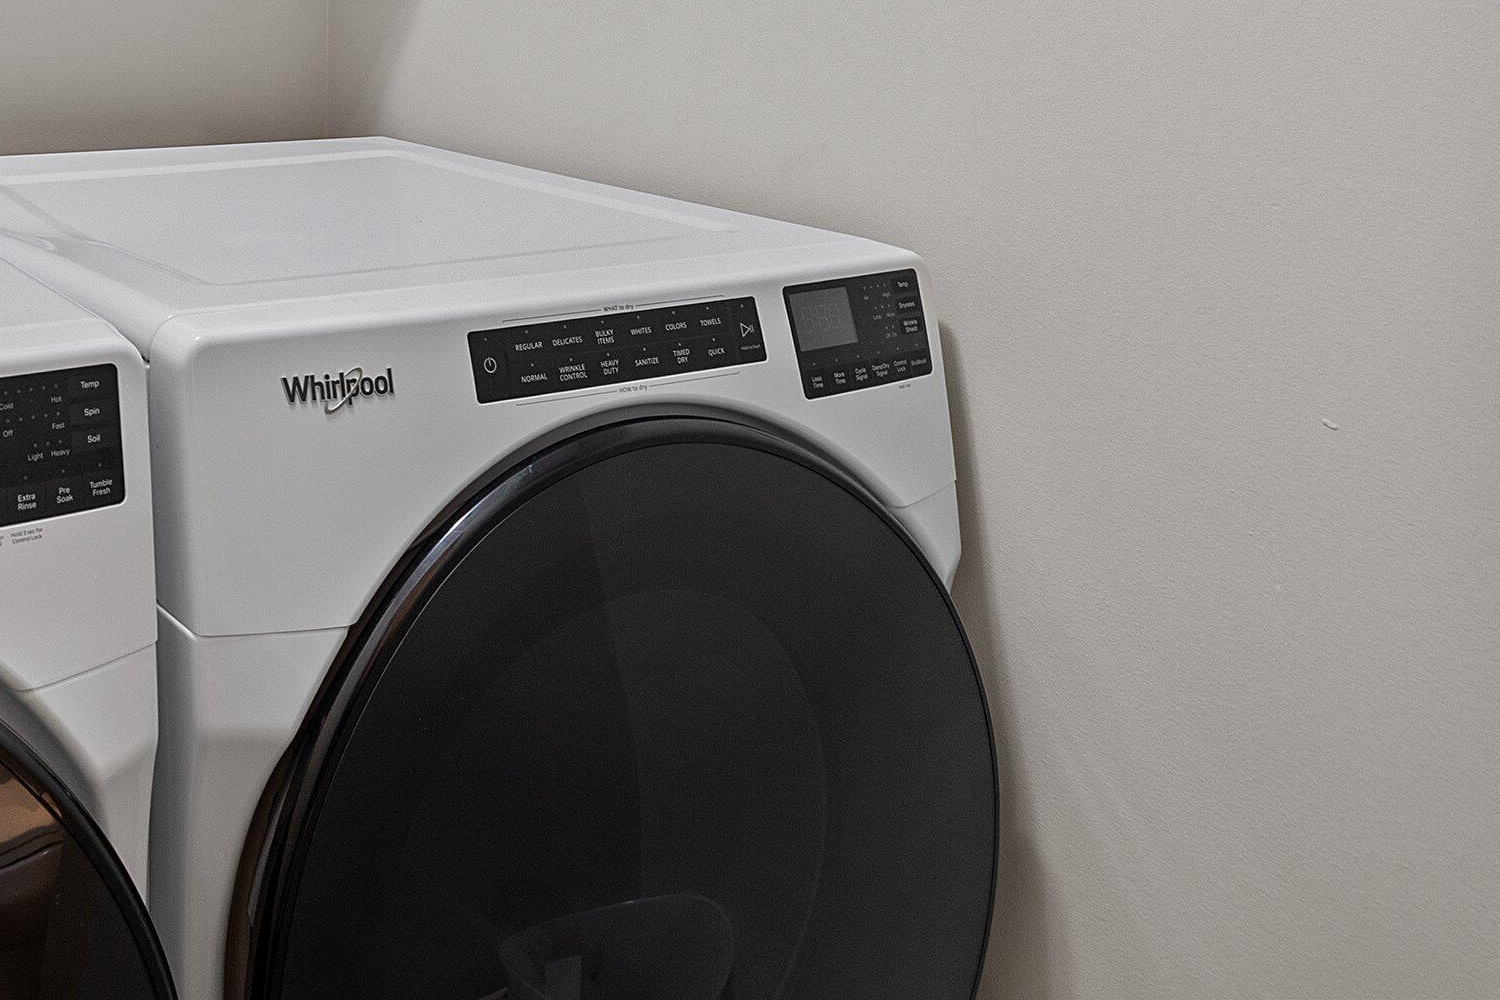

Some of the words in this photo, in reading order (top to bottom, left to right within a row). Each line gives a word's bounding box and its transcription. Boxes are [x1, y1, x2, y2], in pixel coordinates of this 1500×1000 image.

[665, 321, 687, 331] COLORS
[700, 317, 722, 327] TOWELS
[595, 329, 614, 338] BULKY
[630, 326, 652, 335] WHITES
[514, 341, 543, 351] REGULAR
[552, 336, 583, 347] DELICATES
[672, 348, 690, 357] TIMED
[707, 347, 725, 357] QUICK
[600, 359, 619, 368] HEAVY
[635, 356, 660, 367] SANITIZE
[677, 356, 689, 364] DRY
[559, 363, 586, 374] WRINKLE
[603, 367, 619, 375] DUTY
[521, 373, 548, 383] NORMAL
[559, 371, 588, 382] CONTROL
[80, 380, 100, 390] Temp
[281, 367, 395, 406] Whirlpool
[83, 407, 100, 417] Spin
[51, 422, 65, 430] Fast
[2, 429, 14, 438] Off
[87, 434, 101, 443] Soil
[27, 452, 44, 461] Light
[50, 448, 71, 457] Heavy
[89, 478, 113, 489] Tumble
[58, 486, 70, 495] Pre
[92, 487, 111, 497] Fresh
[17, 493, 36, 502] Extra
[56, 494, 74, 504] Soak
[17, 501, 37, 511] Rinse
